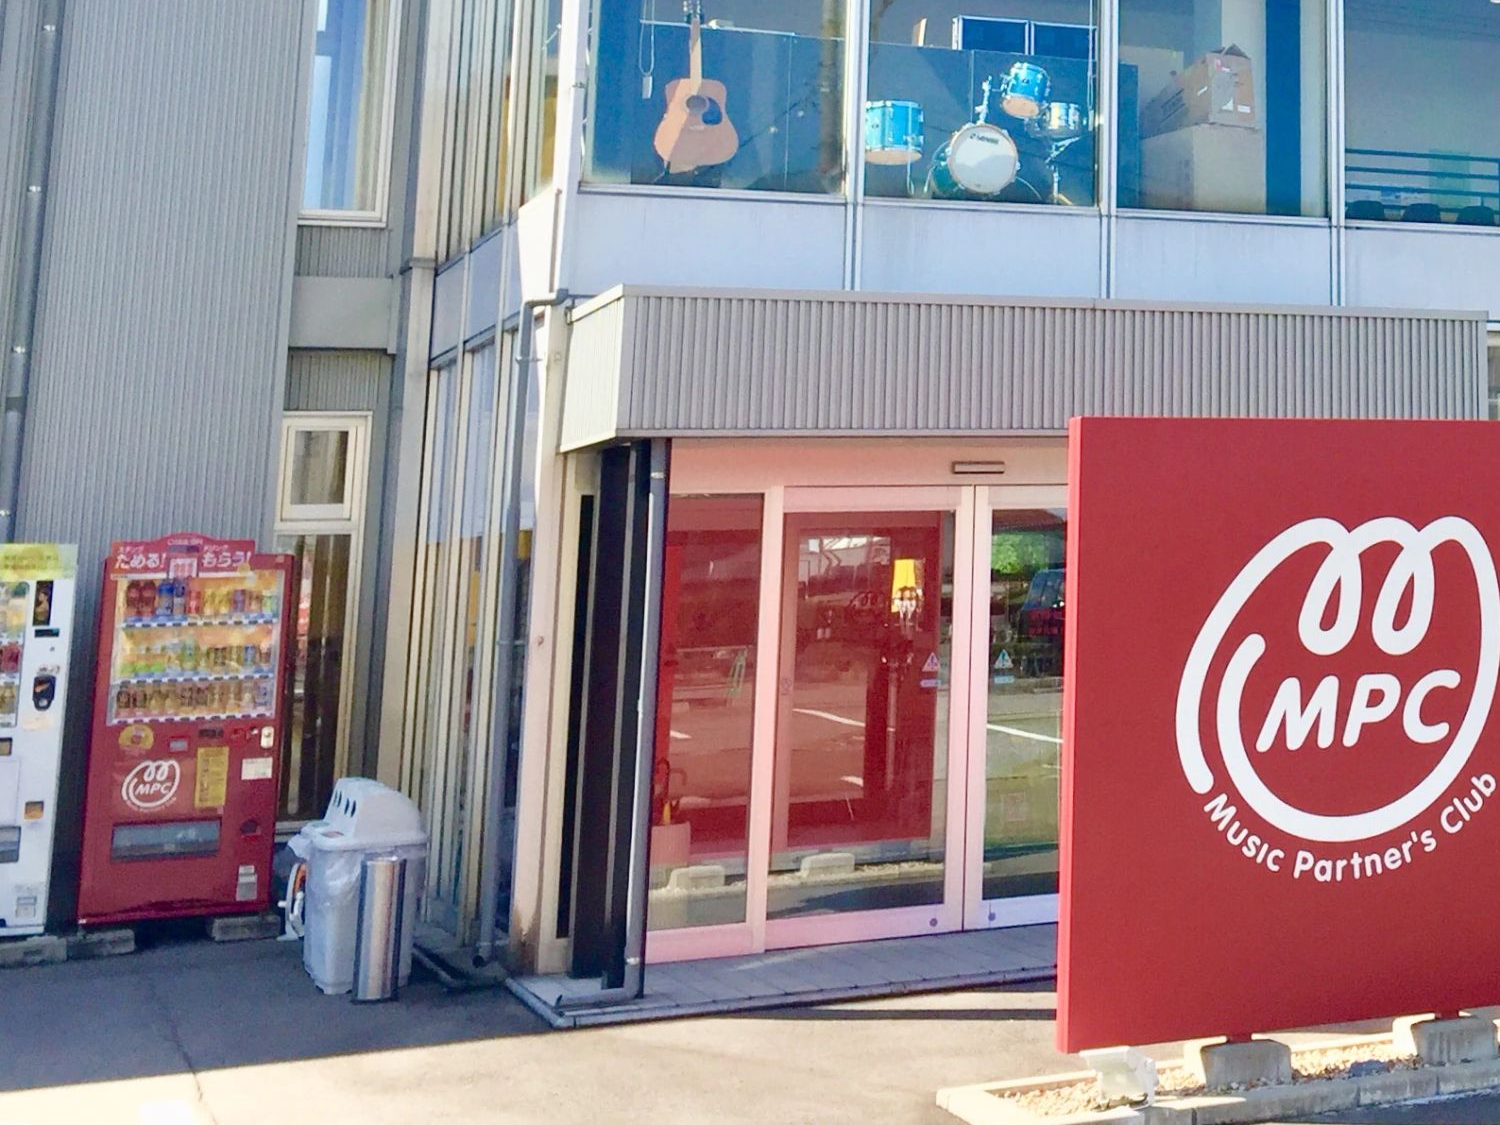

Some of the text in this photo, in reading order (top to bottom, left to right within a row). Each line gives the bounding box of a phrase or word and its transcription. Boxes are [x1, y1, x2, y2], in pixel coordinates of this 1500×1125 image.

[1255, 669, 1461, 753] MPC
[134, 782, 172, 795] MPC
[1203, 773, 1497, 882] Music Partner's Club
